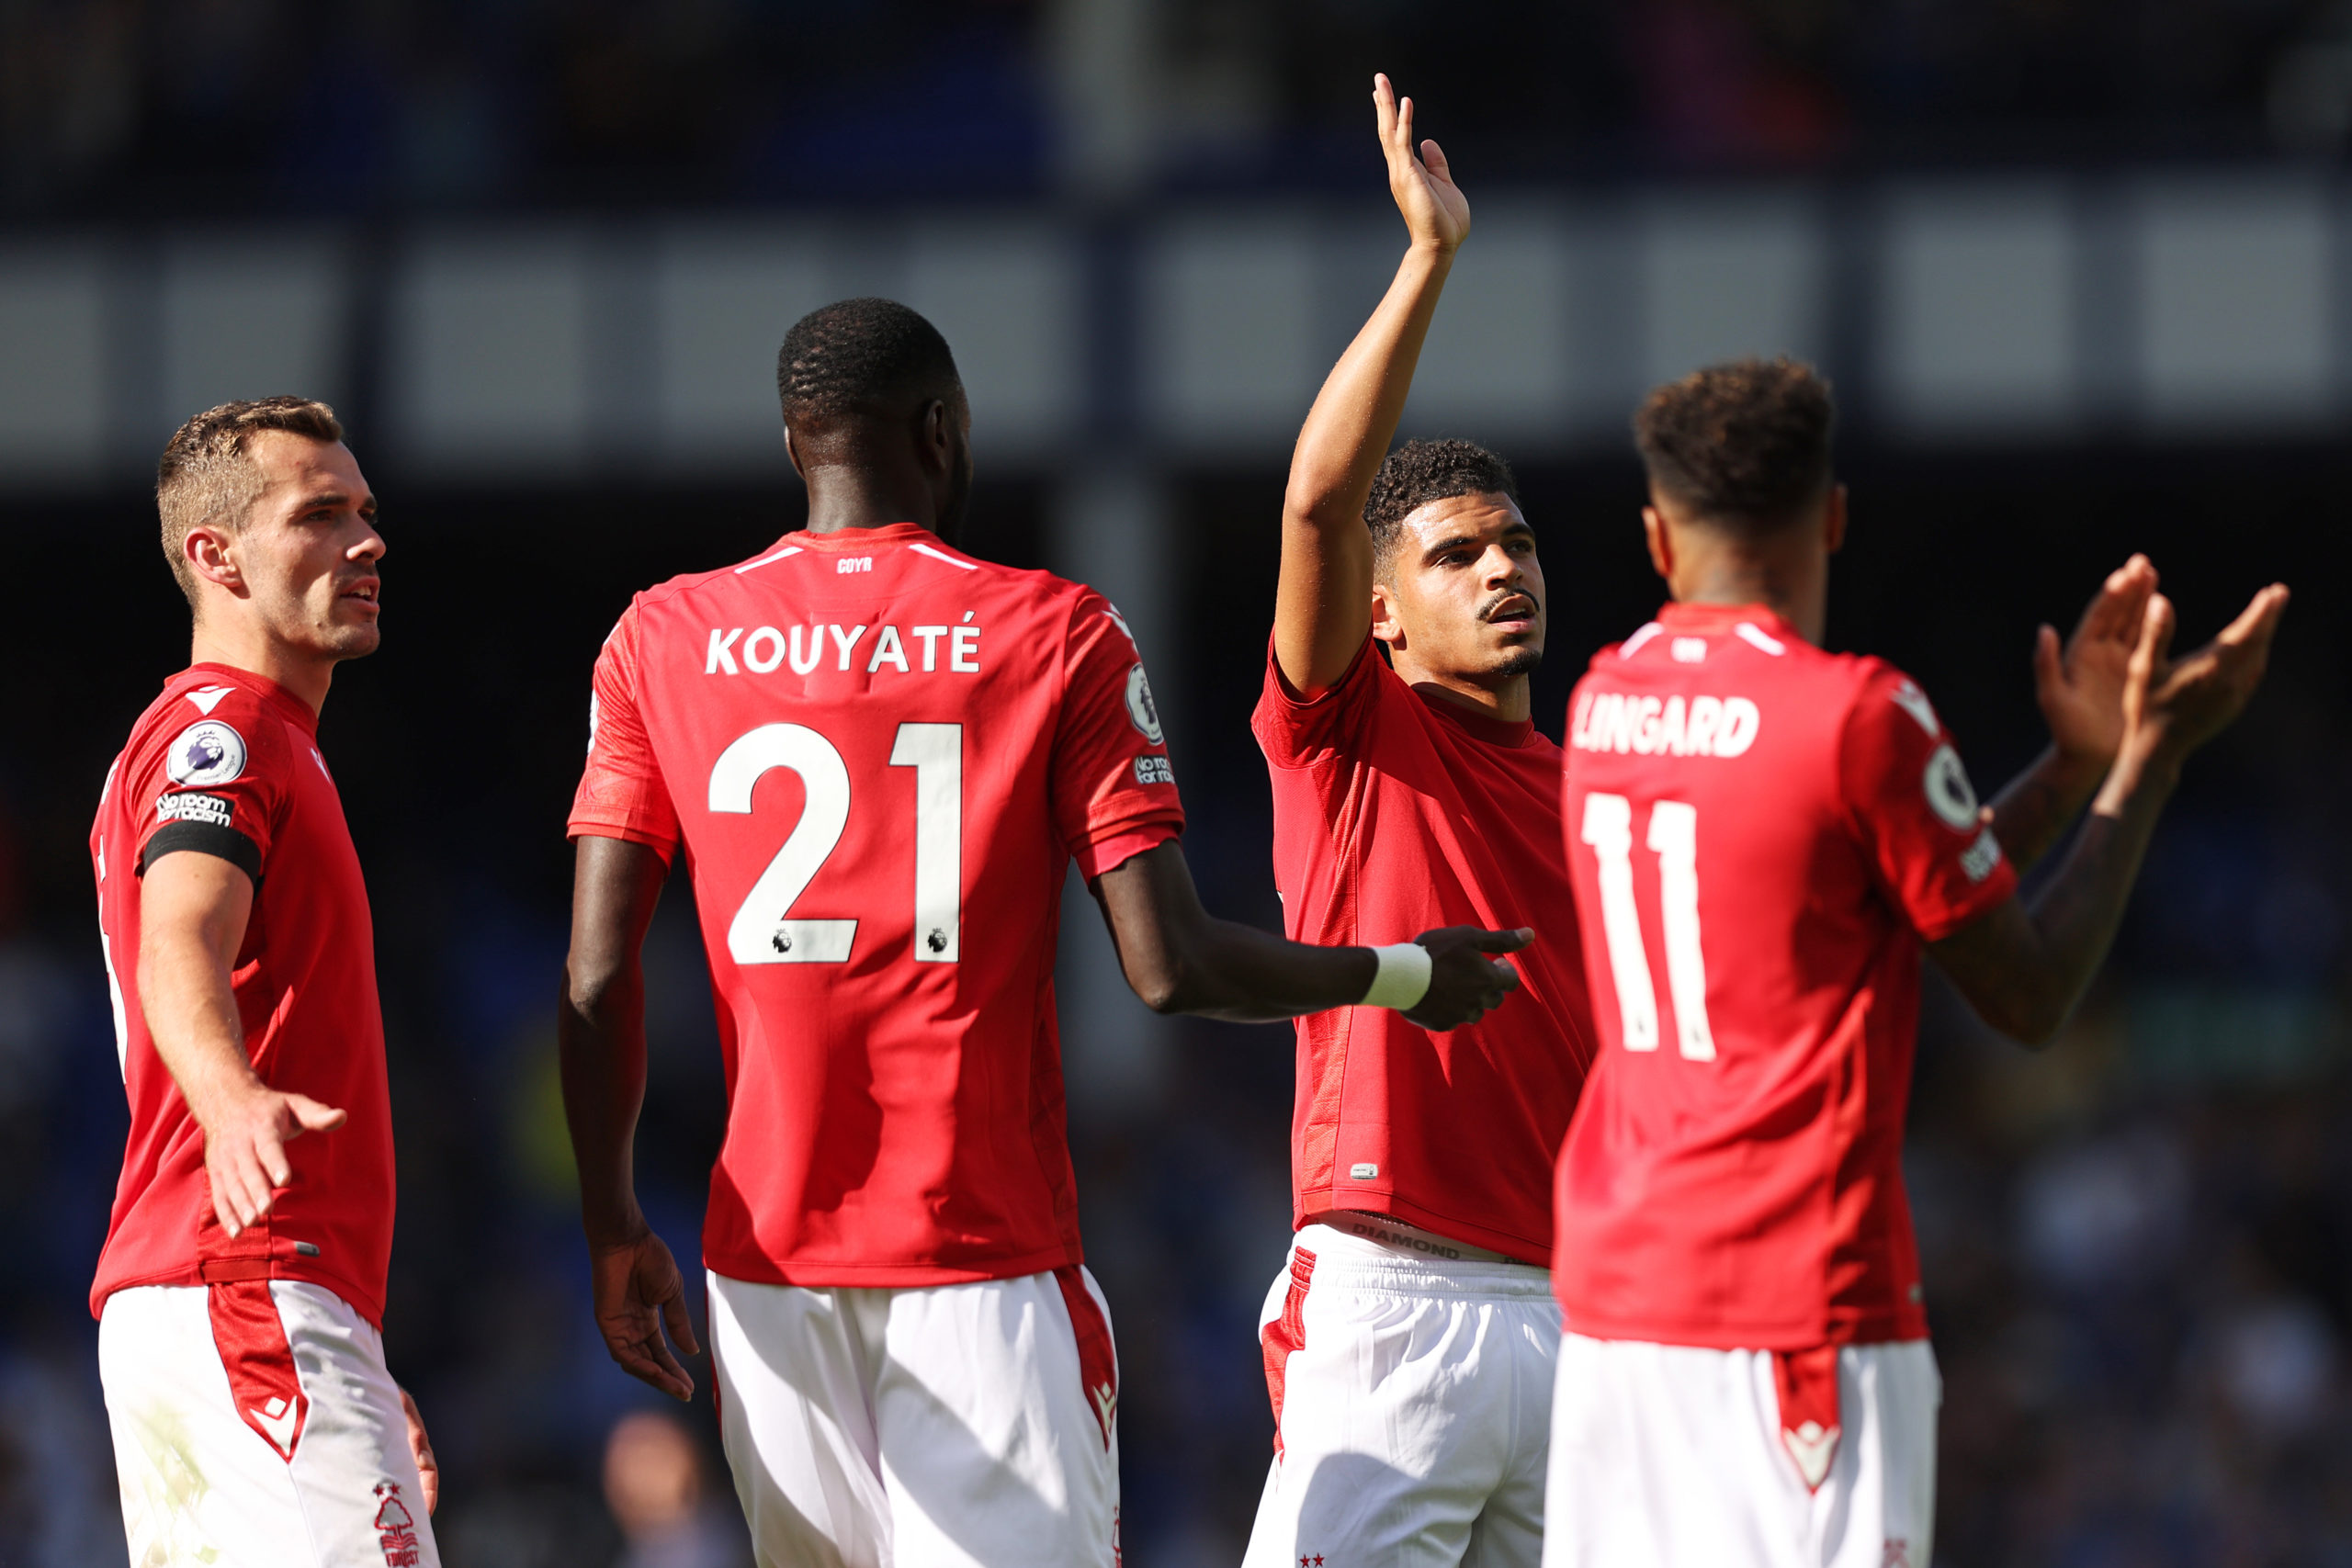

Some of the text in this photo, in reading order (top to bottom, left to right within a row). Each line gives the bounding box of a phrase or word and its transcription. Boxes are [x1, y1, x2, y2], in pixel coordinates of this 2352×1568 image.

[837, 557, 873, 574] COYR
[705, 611, 981, 674] KOUYATÉ
[1571, 691, 1760, 759] LINGARD
[1135, 756, 1154, 772] No
[155, 793, 227, 813] No room
[174, 807, 232, 828] racism
[708, 722, 963, 964] 21
[1581, 791, 1717, 1062] 11
[1351, 1223, 1461, 1260] DIAMOND
